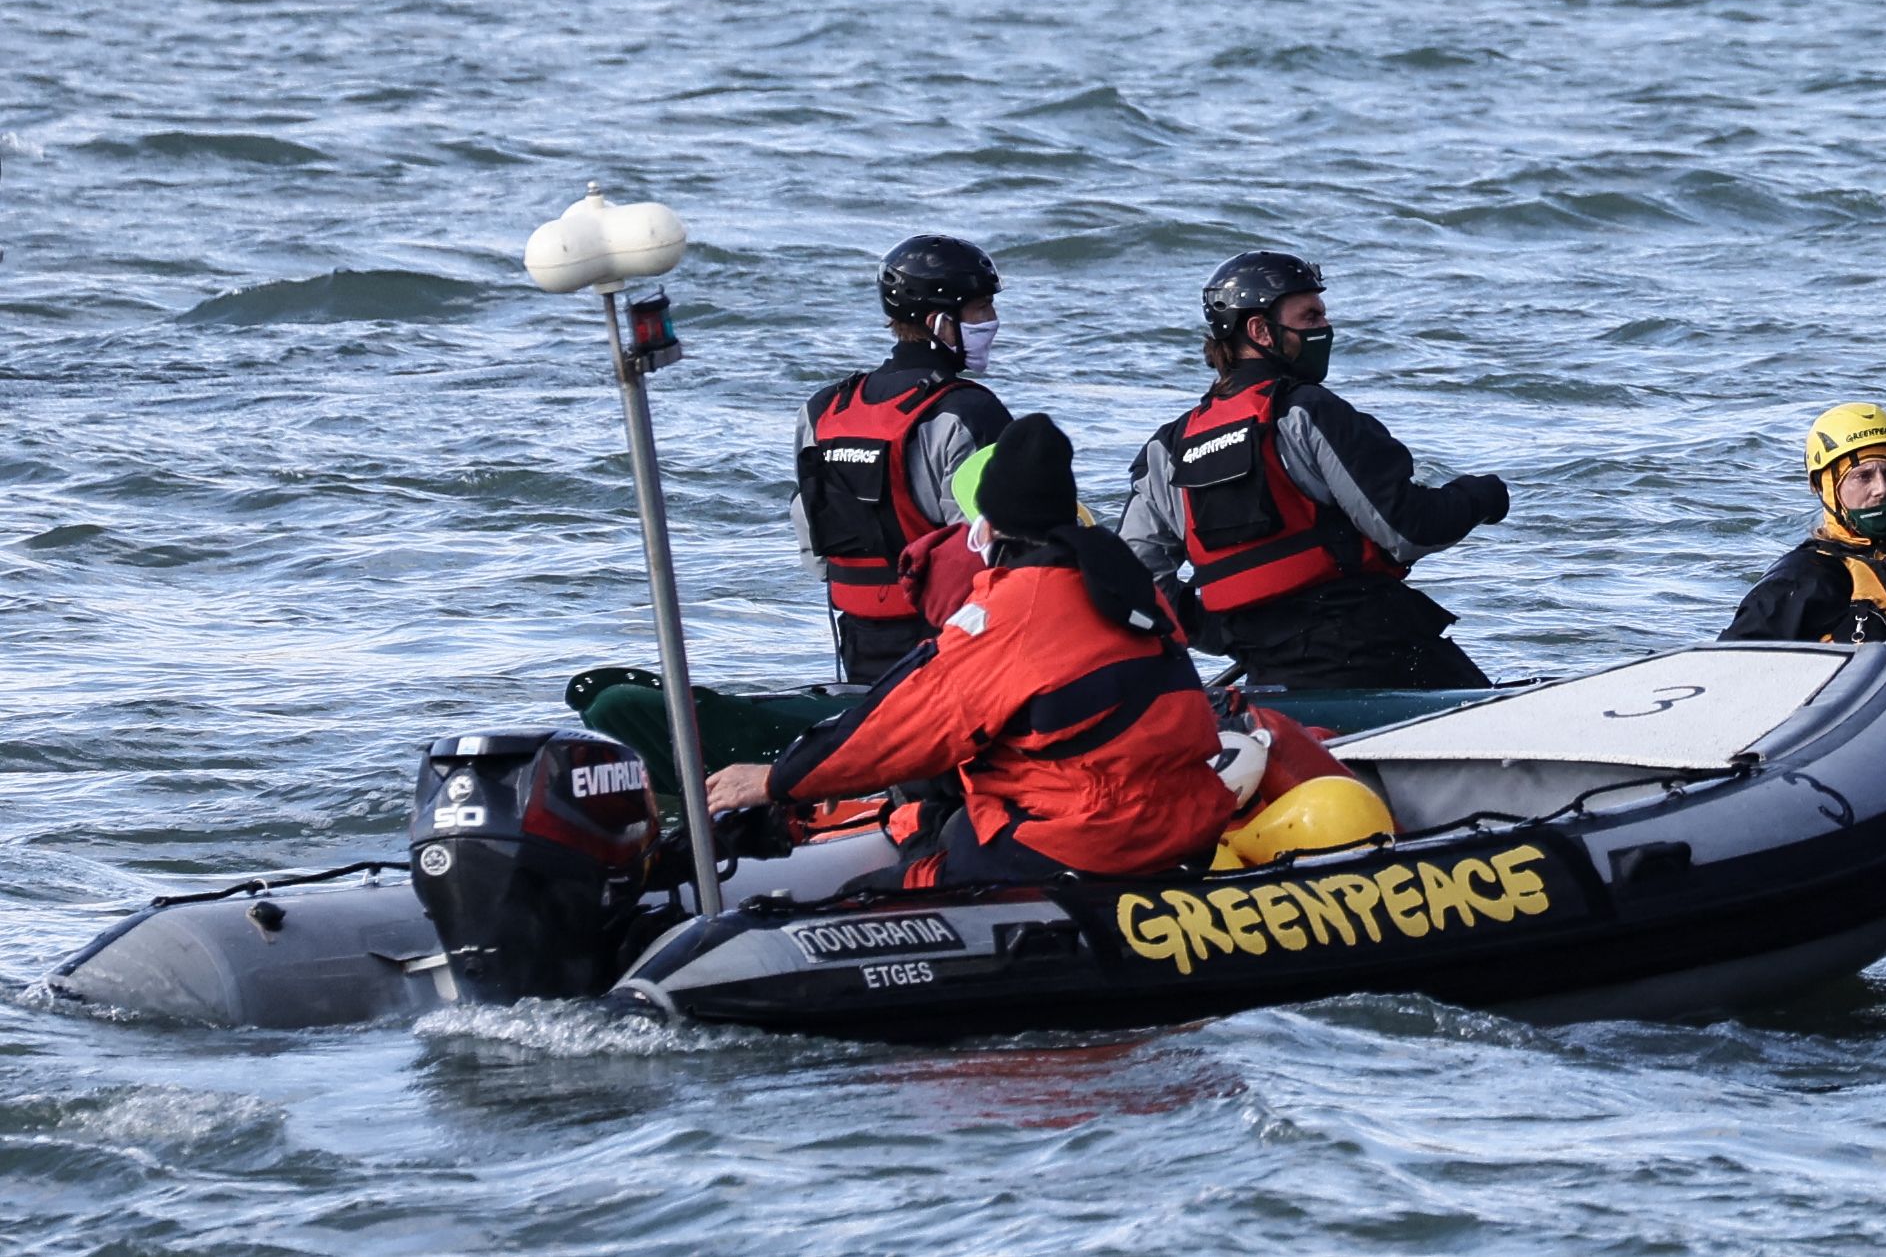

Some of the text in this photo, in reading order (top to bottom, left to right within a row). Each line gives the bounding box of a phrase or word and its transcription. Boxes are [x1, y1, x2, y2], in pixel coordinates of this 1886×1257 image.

[1182, 427, 1249, 464] GREENPEACE
[433, 803, 485, 830] 50
[1116, 844, 1550, 975] GREENPEACE
[862, 960, 935, 990] ETGES
